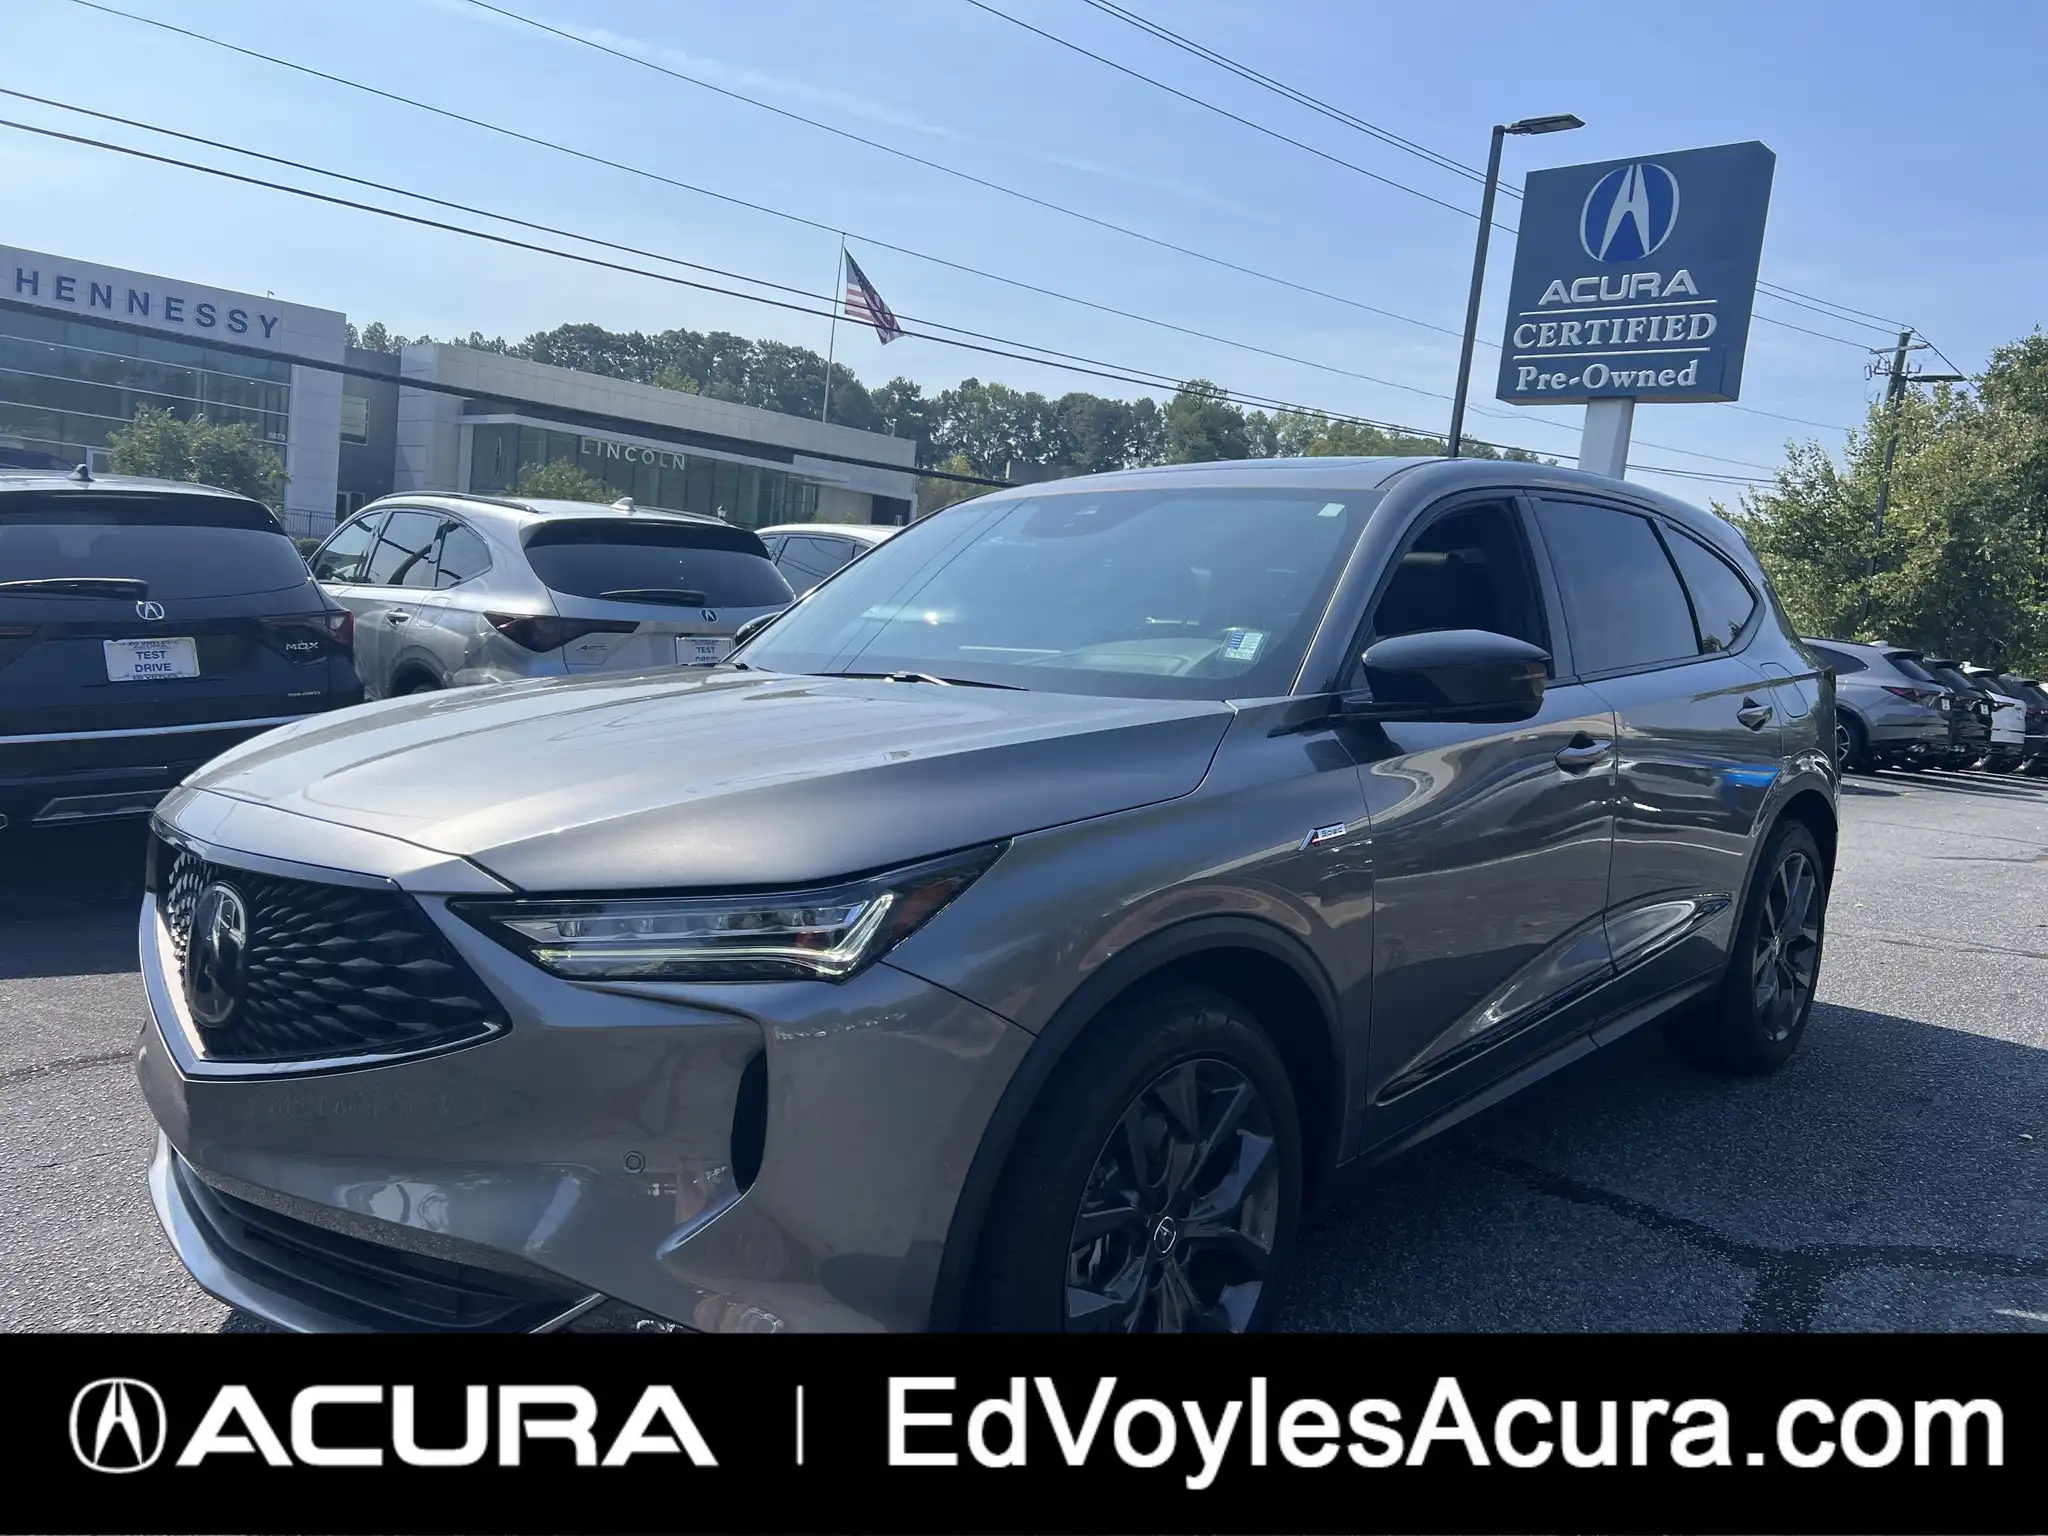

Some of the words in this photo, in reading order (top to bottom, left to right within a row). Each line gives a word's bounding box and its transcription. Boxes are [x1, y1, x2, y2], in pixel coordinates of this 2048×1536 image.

[16, 268, 279, 339] HENNESSY
[1538, 269, 1699, 306] ACURA
[1513, 313, 1718, 349] CERTIFIED
[1516, 359, 1699, 391] Pre-Owned
[581, 437, 685, 471] LINCOLN
[135, 650, 167, 660] TEST
[695, 646, 716, 654] TEST
[134, 662, 172, 673] DRIVE
